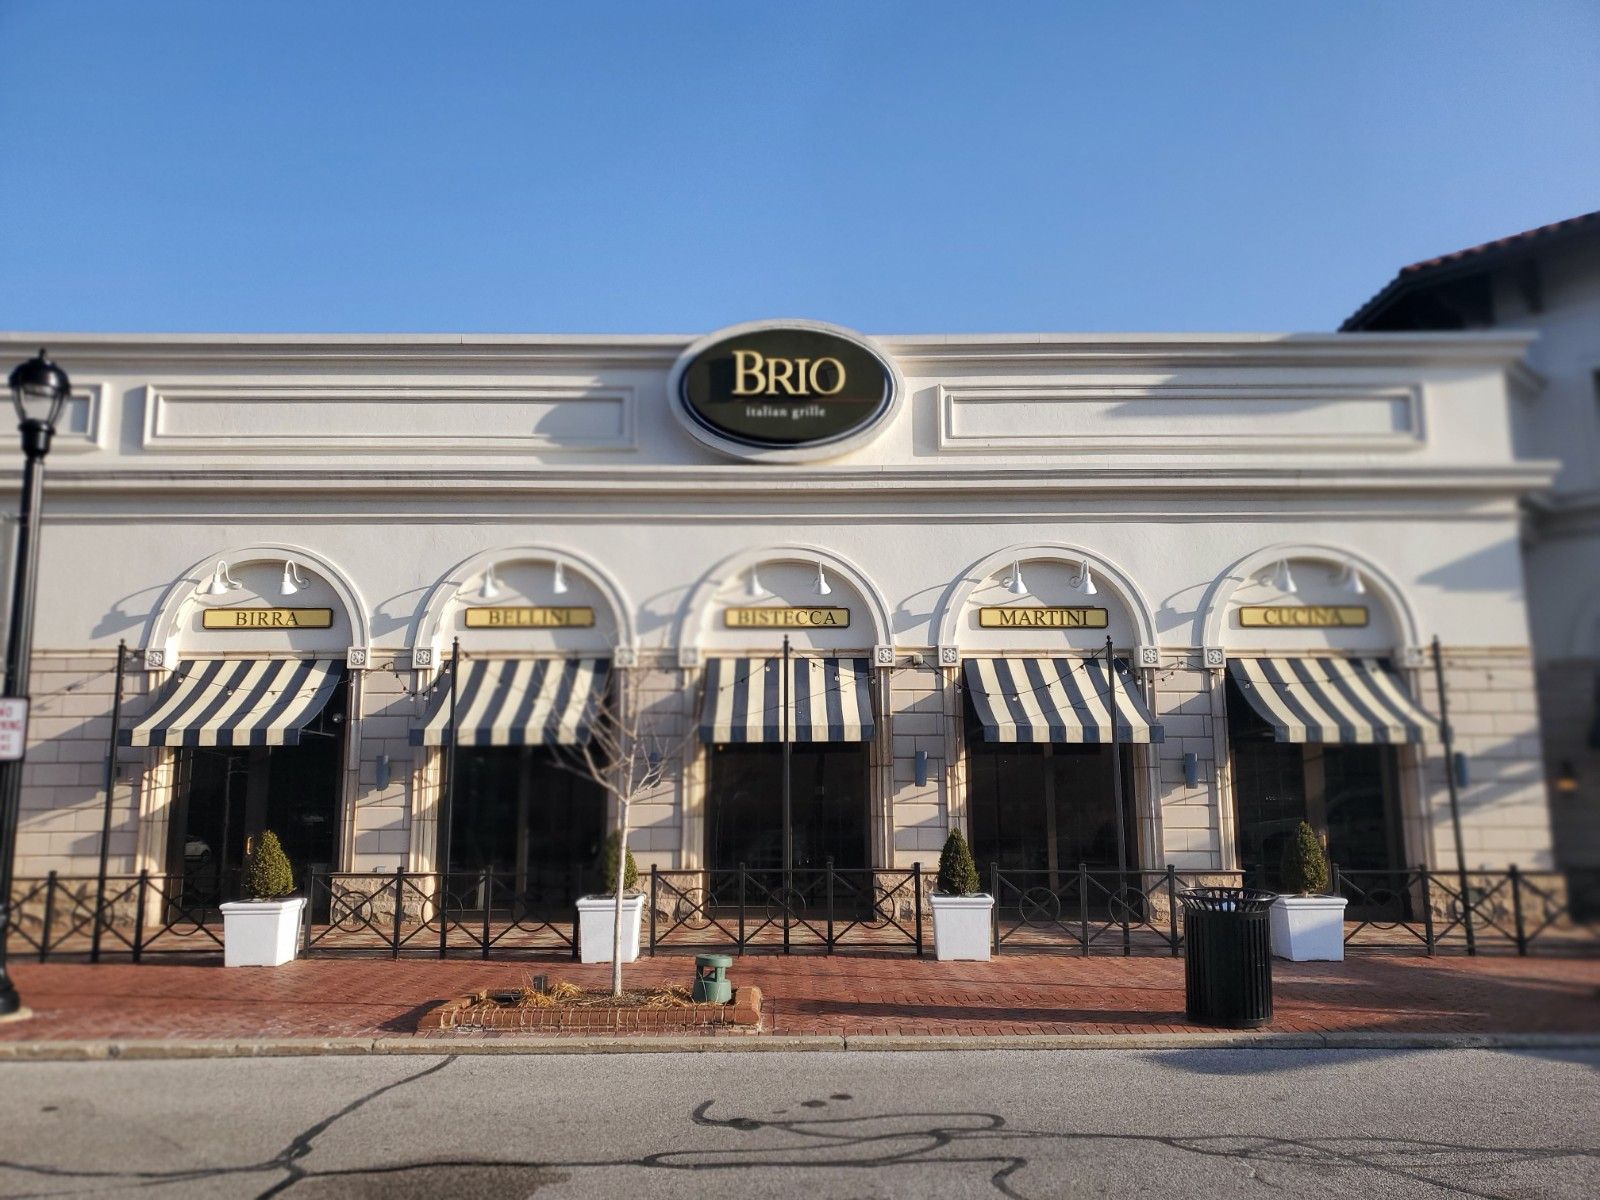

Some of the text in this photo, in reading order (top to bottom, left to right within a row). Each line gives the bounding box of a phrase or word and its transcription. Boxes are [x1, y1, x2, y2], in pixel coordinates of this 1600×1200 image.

[732, 350, 846, 395] BRIO
[746, 404, 826, 419] italian grille
[235, 611, 299, 626] BIRRA
[488, 610, 571, 625] BELLINI
[737, 610, 837, 625] BISTECCA
[999, 609, 1088, 625] MARTINI
[1263, 608, 1343, 625] CUCINA
